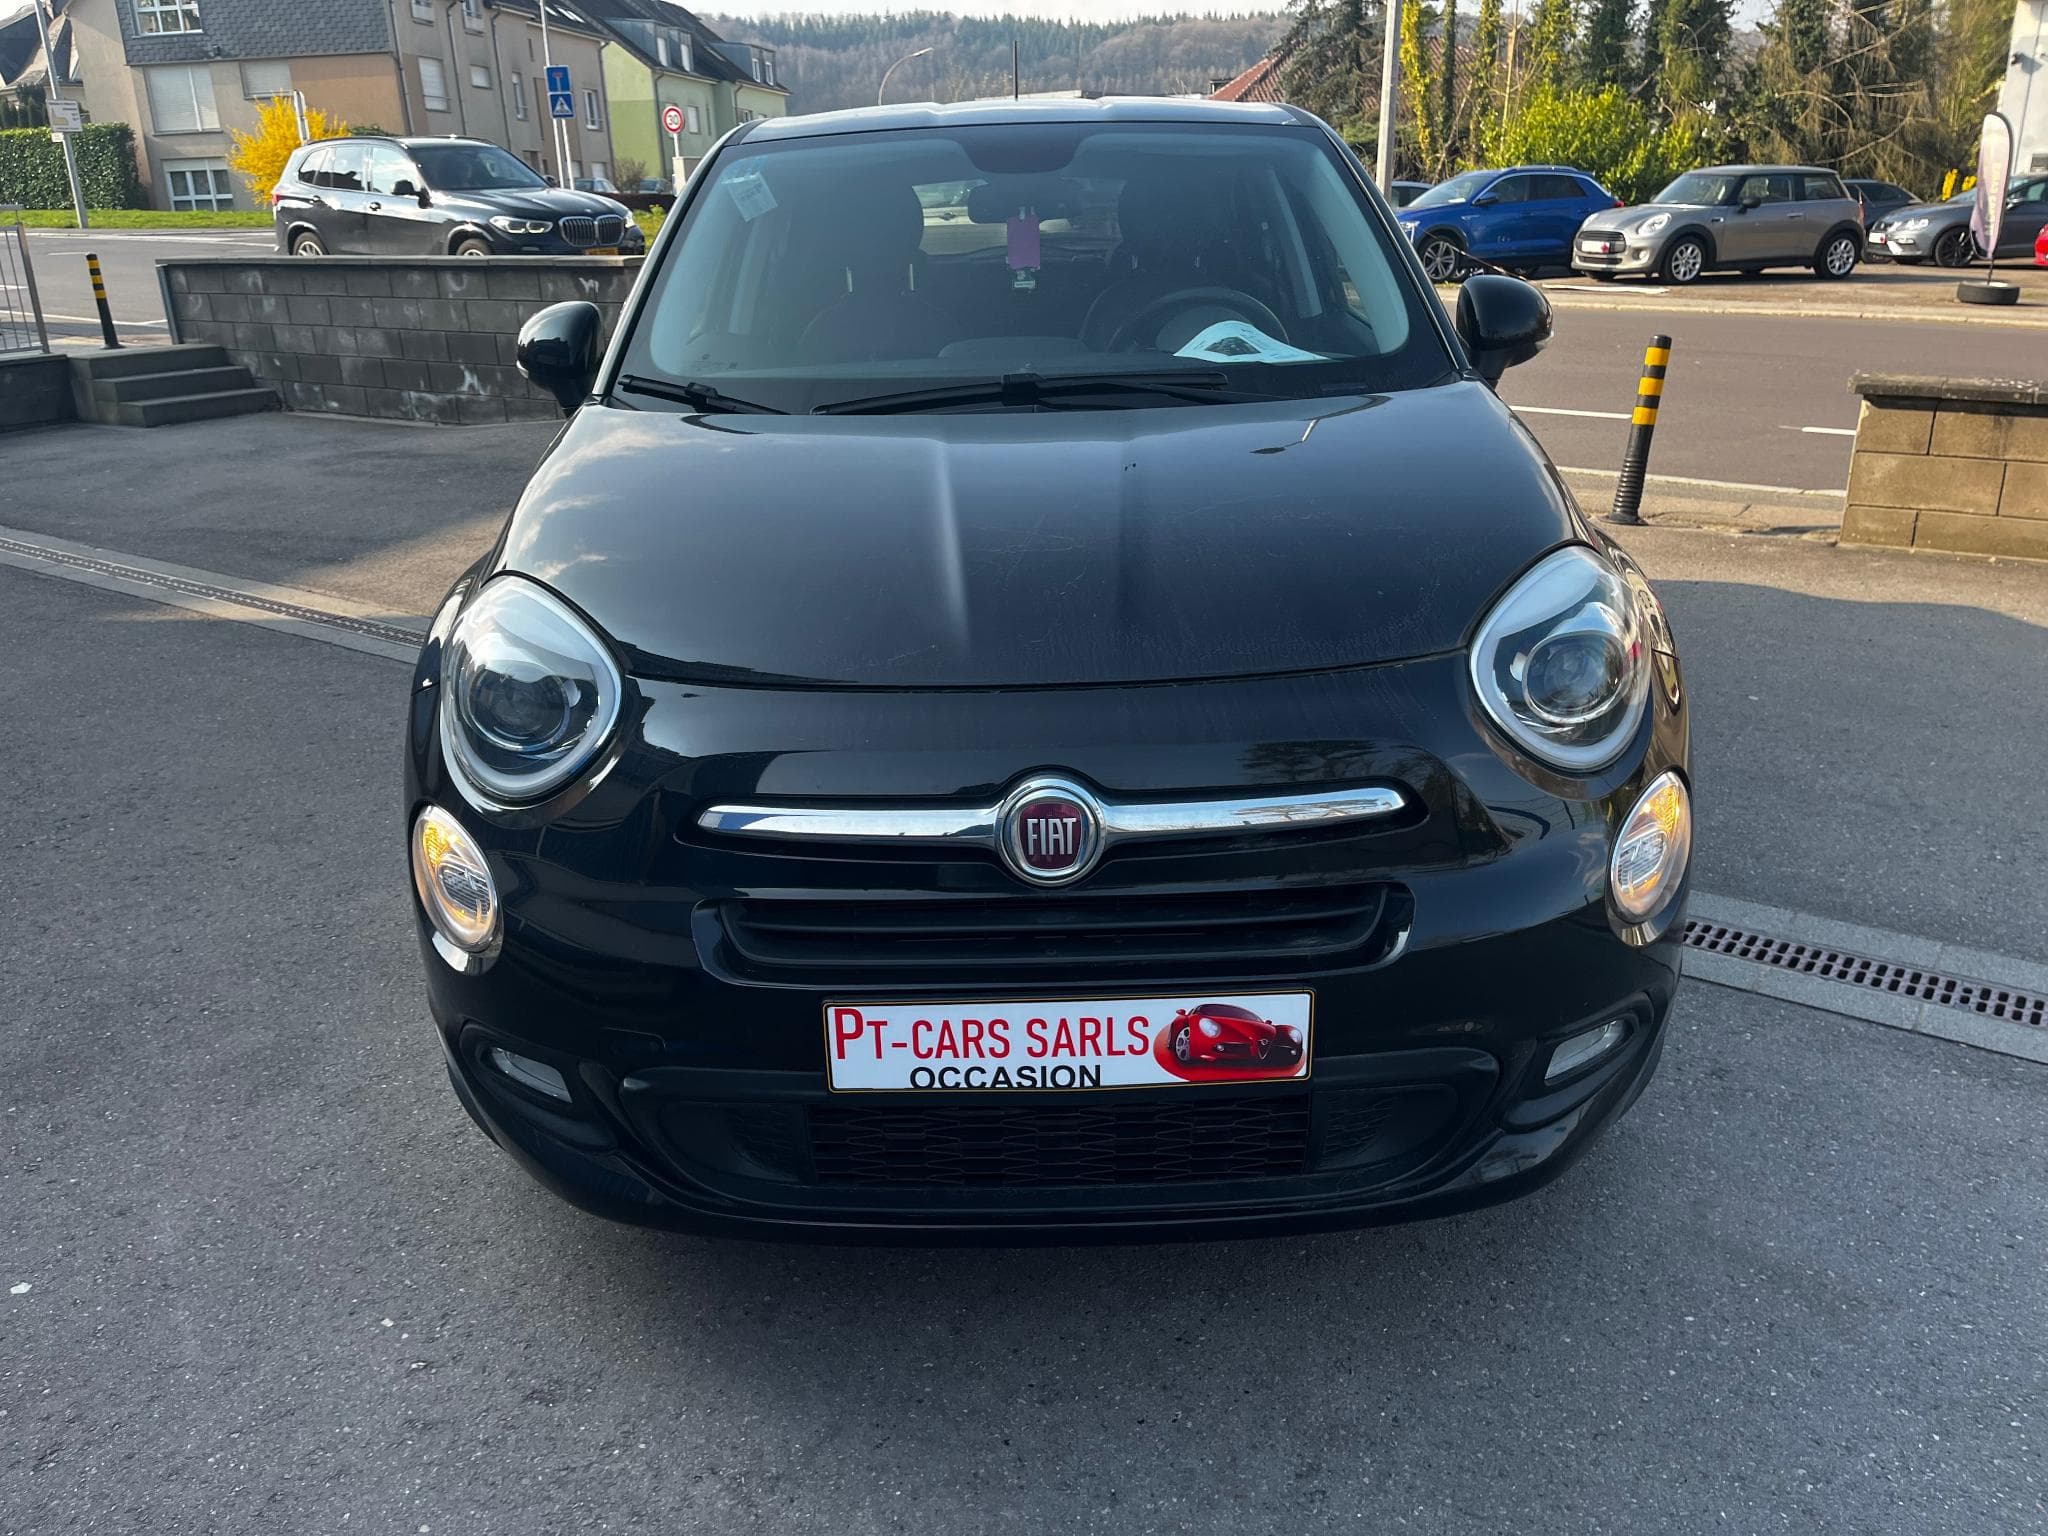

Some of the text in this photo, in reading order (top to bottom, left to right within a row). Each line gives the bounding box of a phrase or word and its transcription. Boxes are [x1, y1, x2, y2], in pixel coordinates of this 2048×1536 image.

[667, 113, 679, 126] 30
[1027, 817, 1077, 856] FIAT
[1025, 1015, 1150, 1059] SARLS
[909, 1064, 1101, 1089] OCCASION
